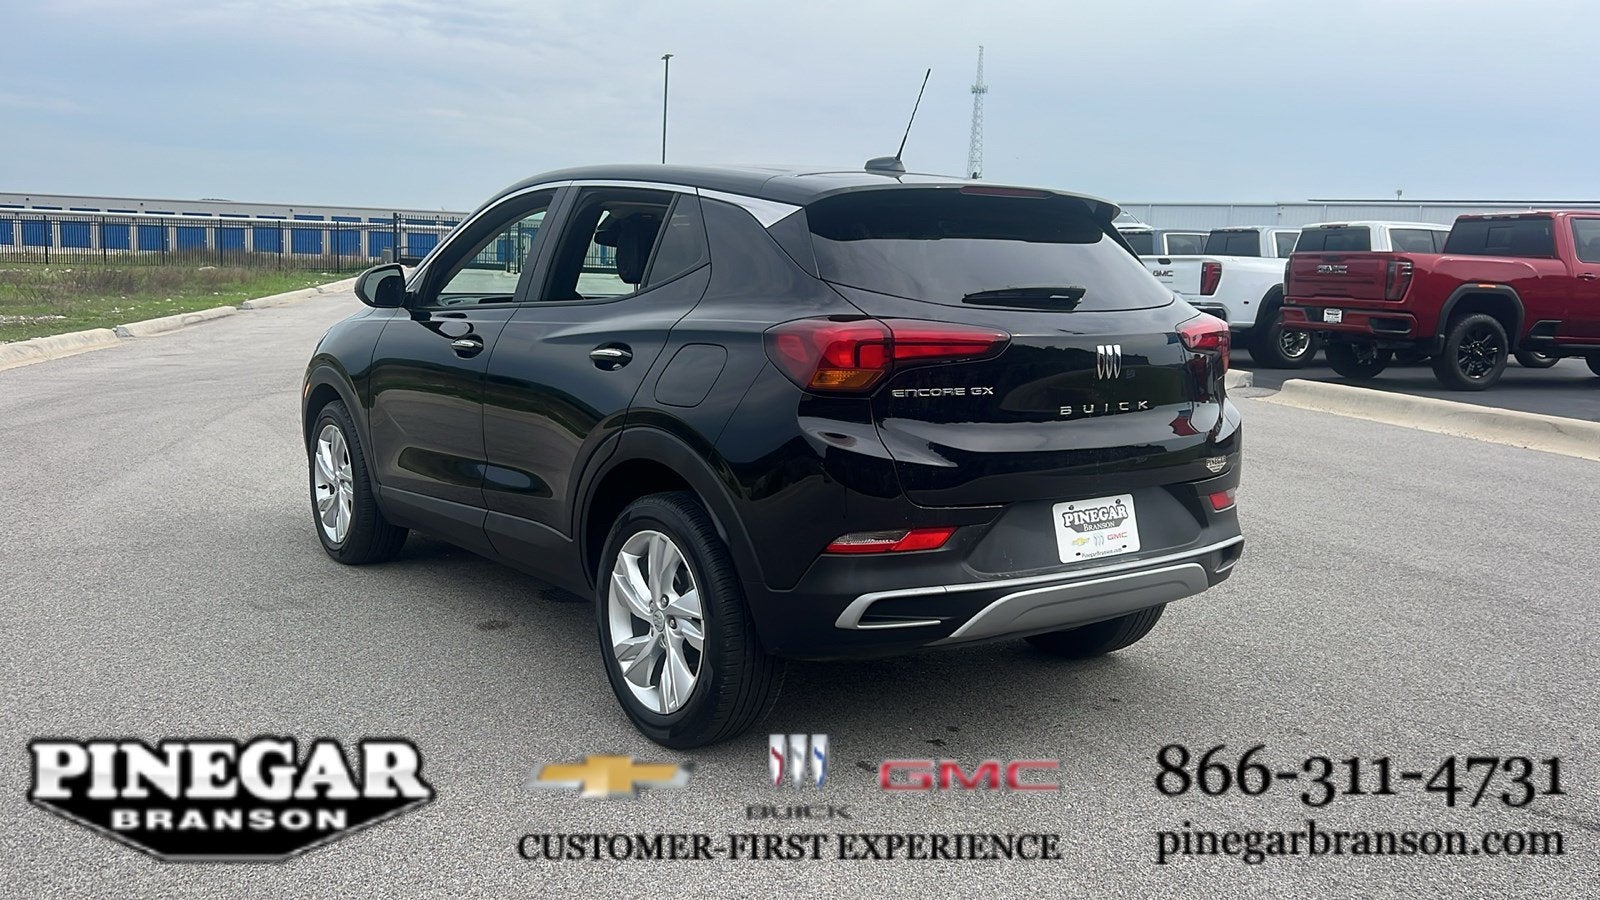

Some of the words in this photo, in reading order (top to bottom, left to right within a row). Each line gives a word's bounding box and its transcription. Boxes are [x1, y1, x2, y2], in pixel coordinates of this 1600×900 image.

[892, 387, 966, 398] ENCORE
[970, 386, 994, 396] GX
[1060, 400, 1148, 416] BUICK
[1062, 504, 1128, 527] PINEGAR
[1083, 520, 1116, 532] BRANSON
[1106, 532, 1128, 541] GMC
